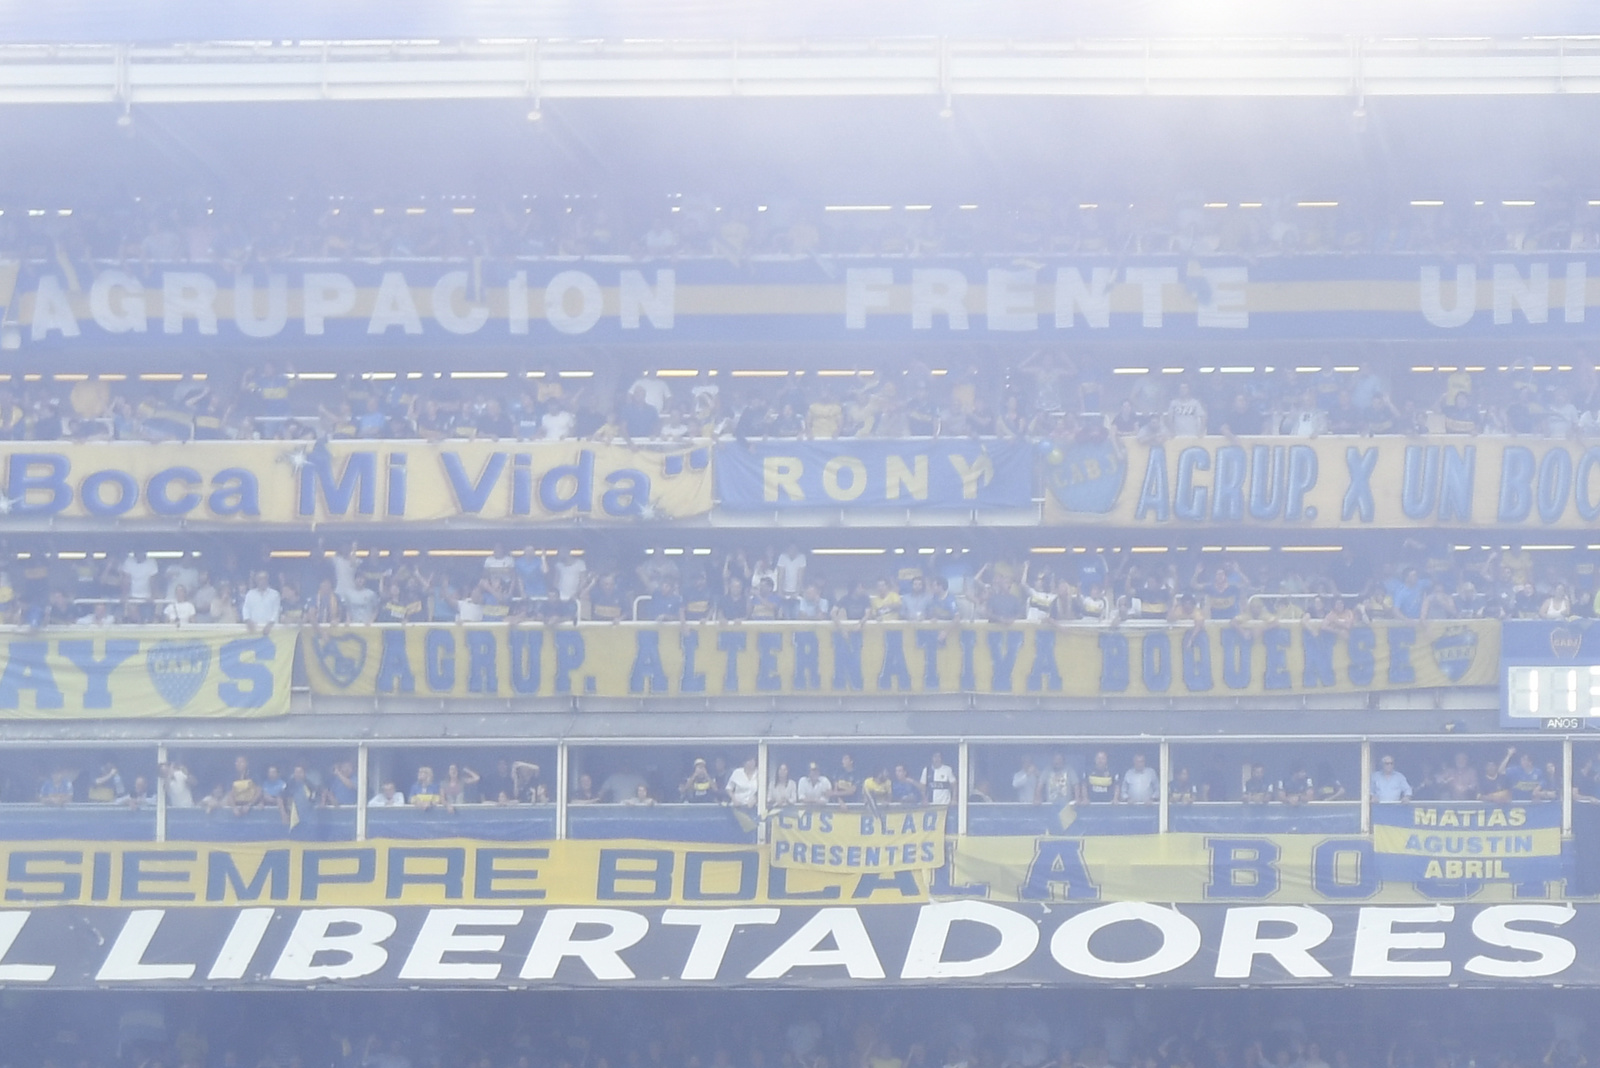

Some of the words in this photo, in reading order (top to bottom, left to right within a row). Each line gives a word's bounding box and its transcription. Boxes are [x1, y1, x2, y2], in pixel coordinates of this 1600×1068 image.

[31, 269, 676, 340] AGRUPACION
[845, 266, 1249, 331] FRENTE
[5, 451, 260, 517] Boca
[302, 450, 408, 517] Mi
[762, 453, 994, 502] RONY
[1134, 444, 1319, 523] AGRUP.
[1342, 445, 1381, 523] X
[1401, 444, 1477, 523] UN
[375, 629, 596, 693] AGRUP.
[628, 628, 1063, 693] ALTERNATIVA
[1100, 627, 1418, 692] BOQUENSE
[1547, 716, 1579, 730] AÑOS
[1404, 833, 1533, 854] AGUSTIN
[1414, 806, 1526, 827] MATIAS
[5, 847, 550, 901] SIEMPRE
[775, 841, 935, 868] PRESENTES
[1425, 858, 1510, 879] ABRIL
[94, 905, 1577, 982] LIBERTADORES
